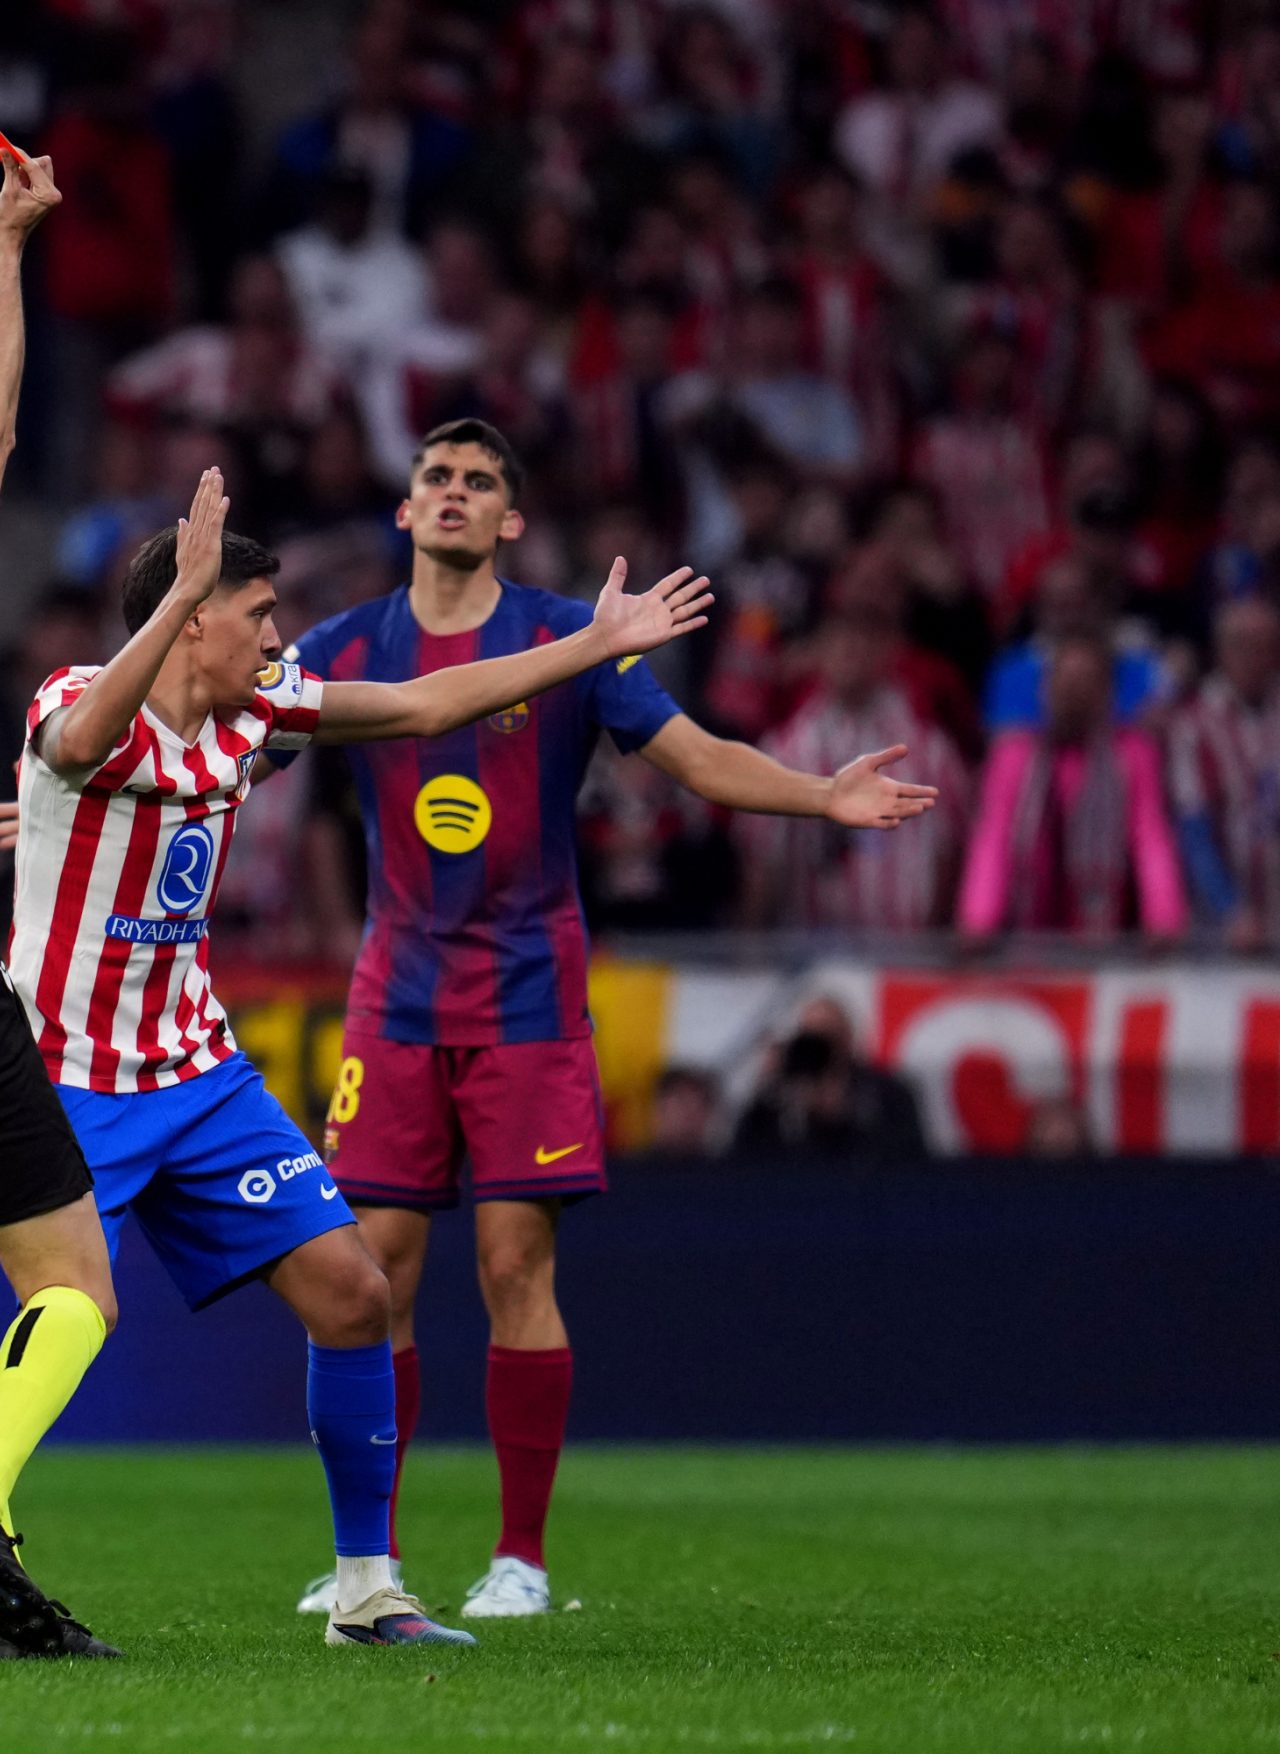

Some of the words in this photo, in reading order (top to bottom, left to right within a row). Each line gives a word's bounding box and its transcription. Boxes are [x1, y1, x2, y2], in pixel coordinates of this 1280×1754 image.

[287, 664, 298, 684] kra
[110, 917, 188, 942] RIYADH
[188, 920, 209, 940] AI
